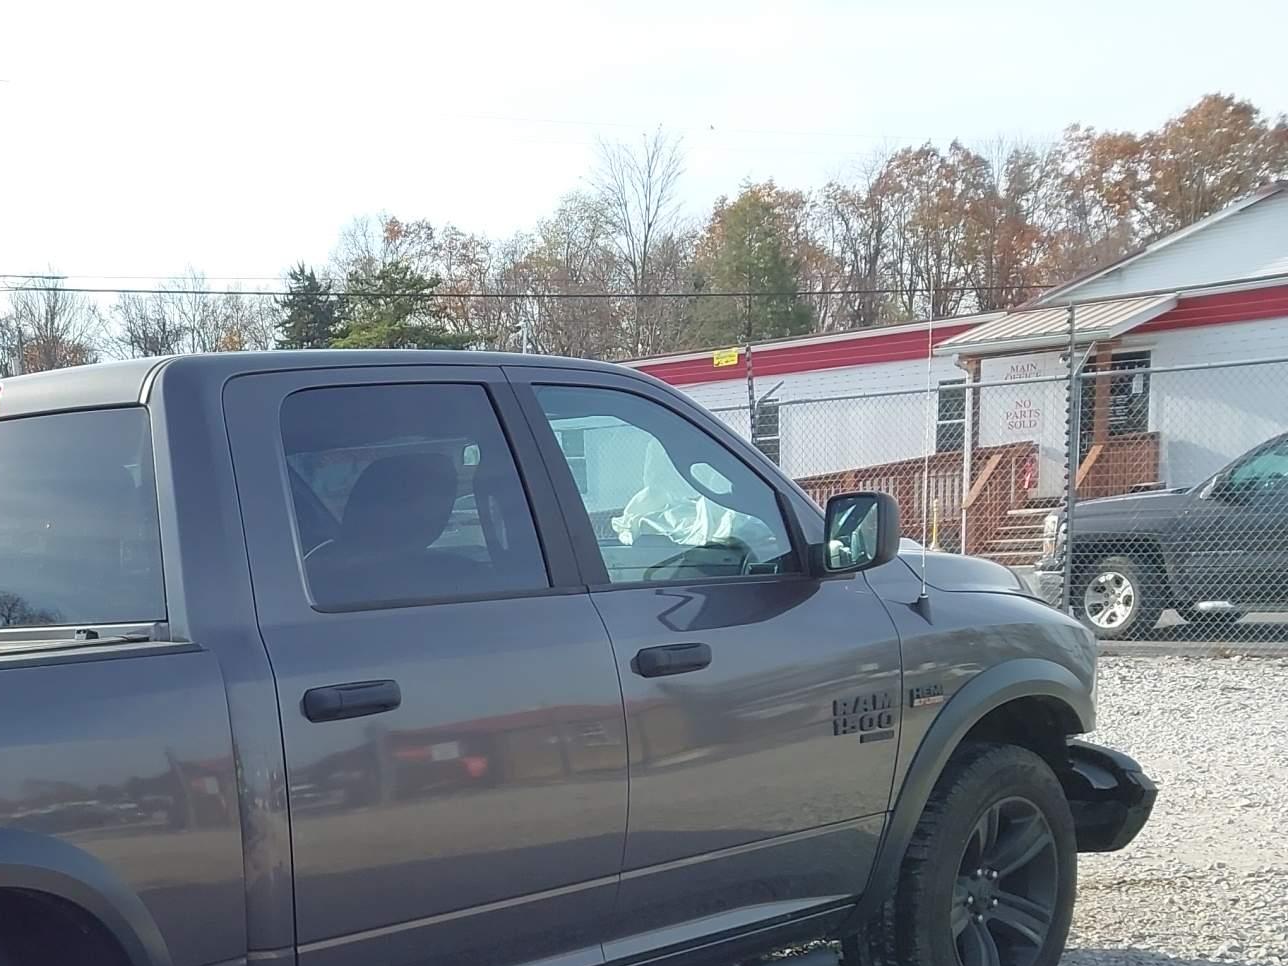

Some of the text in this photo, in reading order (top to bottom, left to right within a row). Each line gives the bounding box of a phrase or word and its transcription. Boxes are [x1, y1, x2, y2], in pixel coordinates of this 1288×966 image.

[1010, 363, 1038, 373] MAIN
[1015, 400, 1032, 409] NO
[1006, 408, 1041, 420] PARTS
[1008, 420, 1038, 430] SOLD
[832, 692, 892, 717] RAM
[832, 711, 892, 736] 1500
